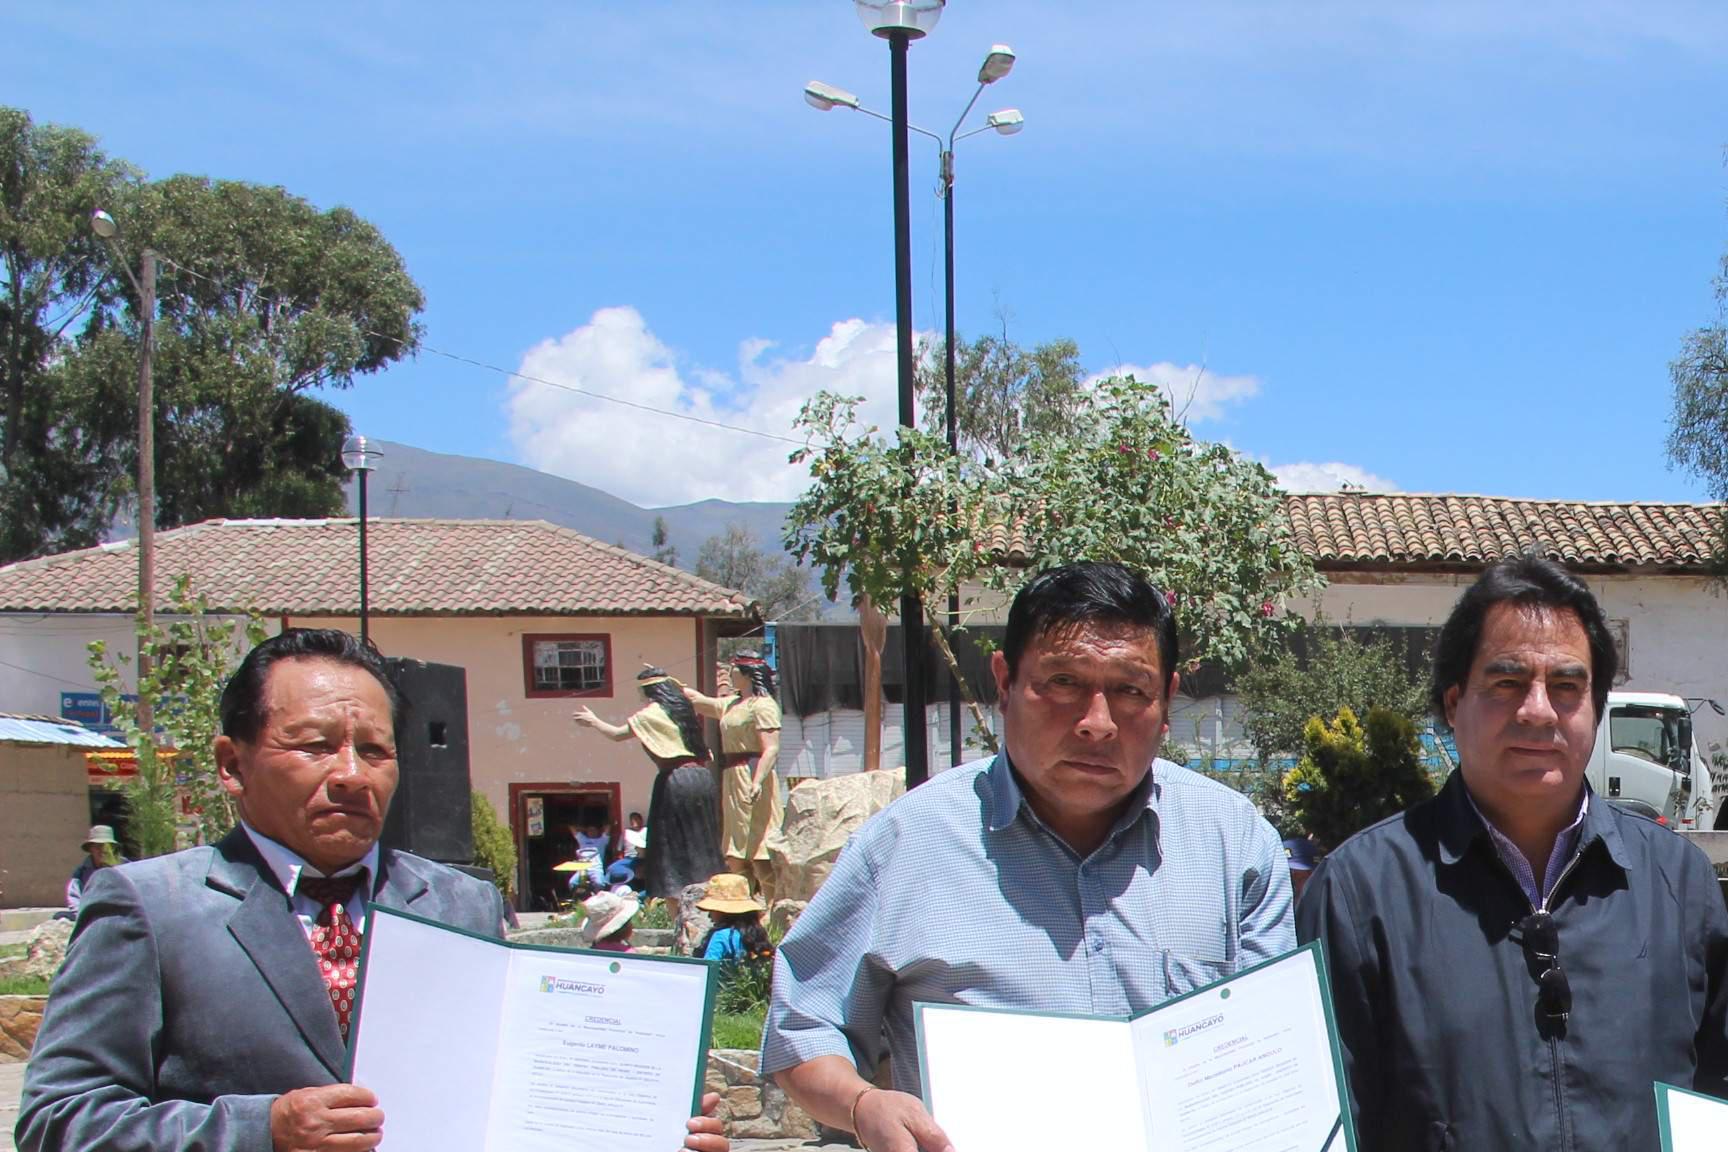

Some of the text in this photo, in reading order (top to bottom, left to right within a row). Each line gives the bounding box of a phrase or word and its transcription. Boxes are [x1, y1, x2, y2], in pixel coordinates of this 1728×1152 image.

[555, 982, 605, 994] HUANCAYO
[585, 1015, 622, 1026] CREDENCIAL
[1178, 1015, 1225, 1038] HUANCAYO
